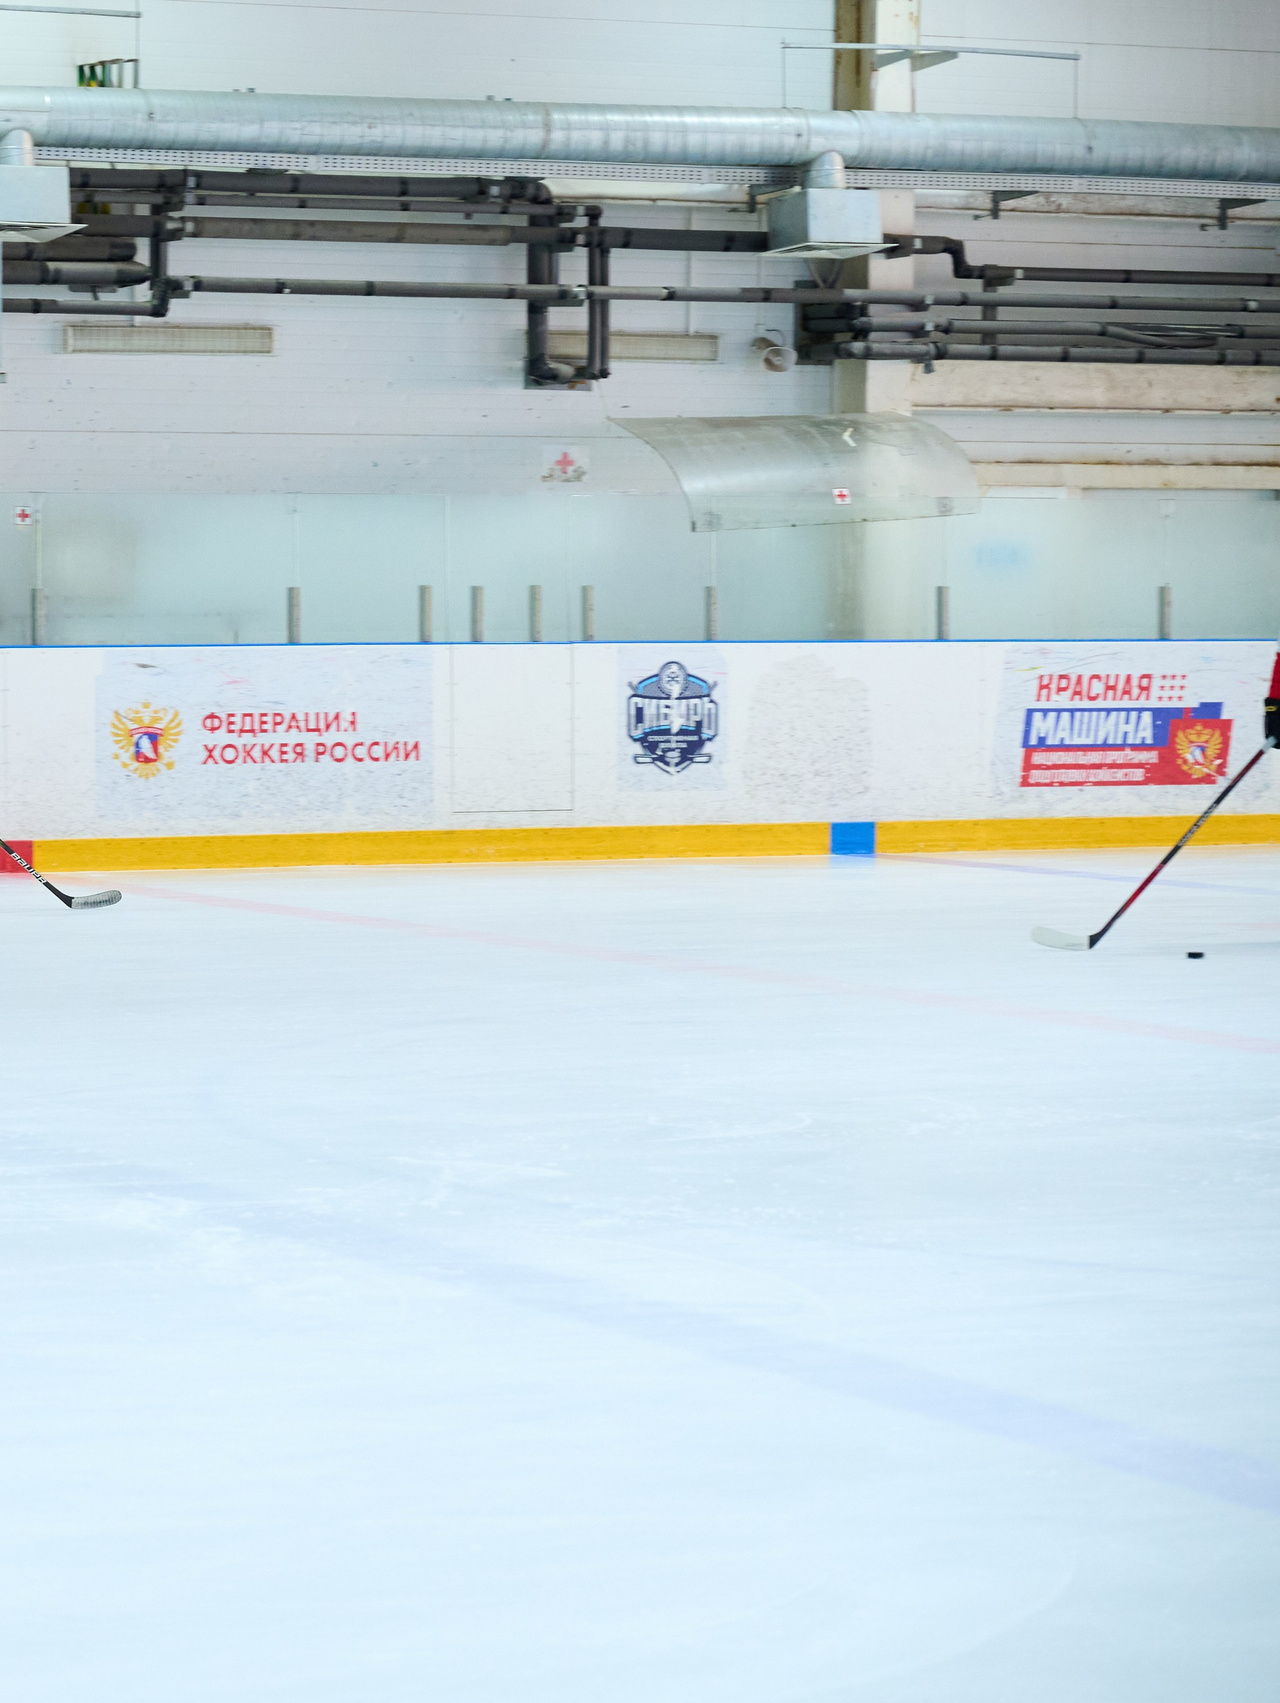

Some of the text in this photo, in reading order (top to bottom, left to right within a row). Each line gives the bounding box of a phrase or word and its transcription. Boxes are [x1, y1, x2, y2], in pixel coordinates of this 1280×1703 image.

[1035, 673, 1153, 702] КРАСНАЯ
[1028, 711, 1154, 745] МАШИНА
[201, 740, 421, 765] ХОККЕЯ РОССИИ
